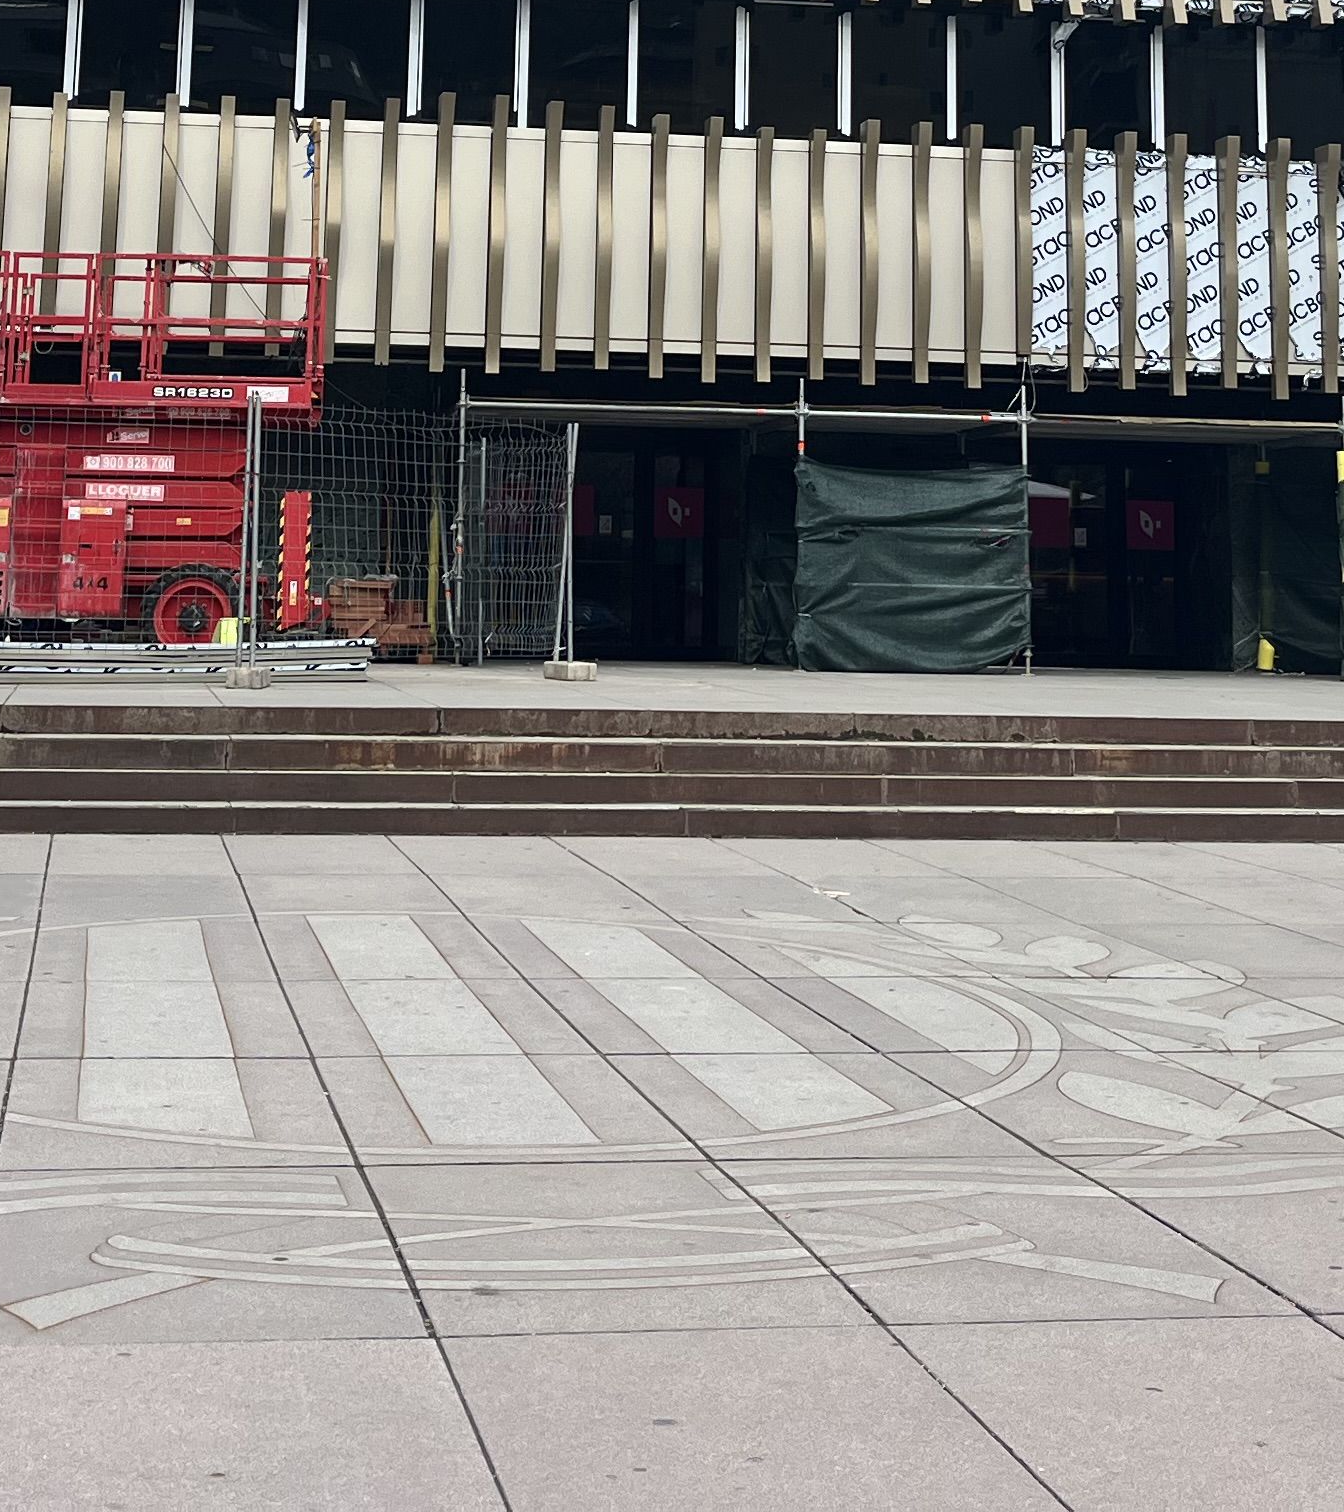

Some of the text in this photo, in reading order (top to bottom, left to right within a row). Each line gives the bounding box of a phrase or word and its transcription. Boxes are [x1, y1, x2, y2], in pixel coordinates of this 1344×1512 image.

[102, 457, 172, 469] 900 828 700
[89, 485, 162, 497] LLOGUER
